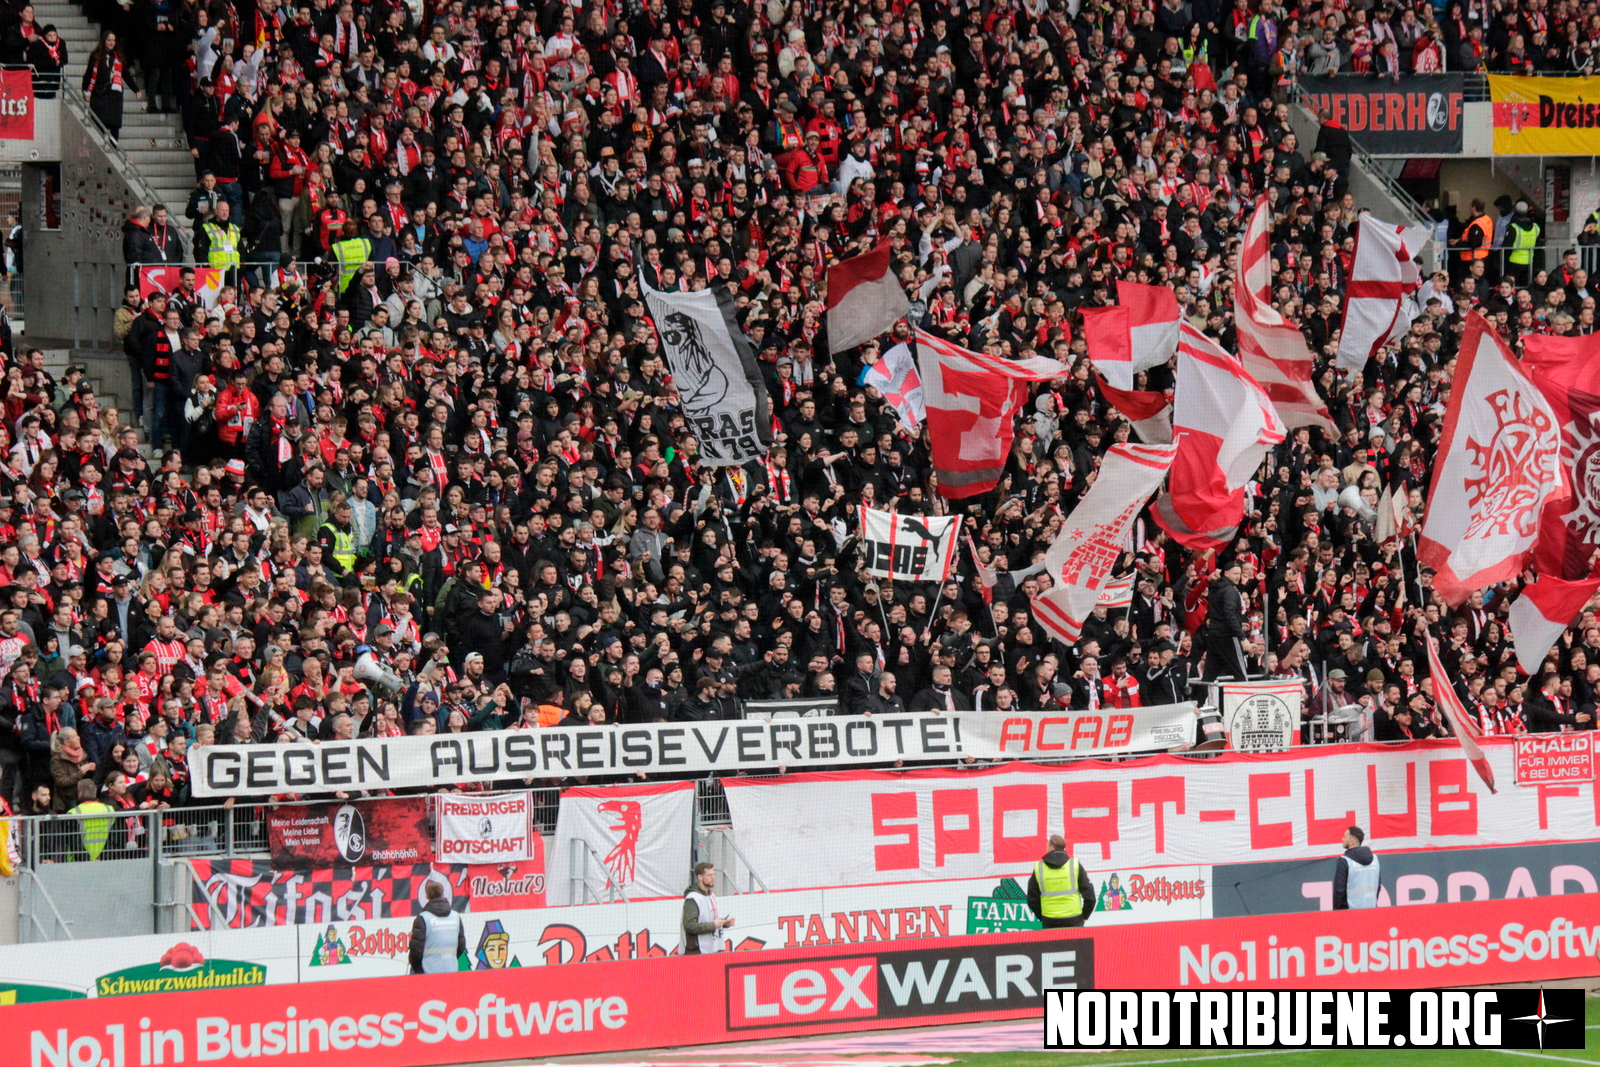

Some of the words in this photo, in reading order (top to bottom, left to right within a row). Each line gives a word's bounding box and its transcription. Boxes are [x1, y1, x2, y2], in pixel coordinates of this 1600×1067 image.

[1539, 95, 1600, 128] Dreis
[1150, 726, 1184, 736] FREIBURG
[1241, 737, 1283, 745] SYNTHESIA
[1519, 737, 1589, 755] KHALID
[207, 744, 390, 790] GEGEN
[431, 717, 963, 778] AUSREISEVERBOTE!
[999, 714, 1135, 752] ACAB
[1519, 755, 1545, 768] FÜR
[1548, 754, 1590, 766] IMMER
[1529, 768, 1549, 779] BEI
[1552, 767, 1580, 778] UNS
[443, 799, 525, 816] FREIBURGER
[271, 819, 291, 827] Meine
[291, 816, 329, 826] Leidenschaft
[282, 828, 302, 837] Meine
[303, 827, 319, 836] Liebe
[285, 838, 300, 846] Mein
[301, 837, 321, 845] Verein
[442, 837, 525, 854] BOTSCHAFT
[472, 874, 546, 897] Nostra79
[1127, 874, 1206, 906] Rothaus
[971, 901, 1041, 922] TANN
[778, 904, 953, 949] TANNEN
[346, 925, 414, 959] Rotha
[1179, 941, 1256, 986] No.1
[1268, 935, 1305, 980] in
[99, 966, 264, 996] Schwarzwaldmilch
[31, 1023, 125, 1067] No.1
[140, 1016, 184, 1066] in
[197, 993, 628, 1062] Business-Software
